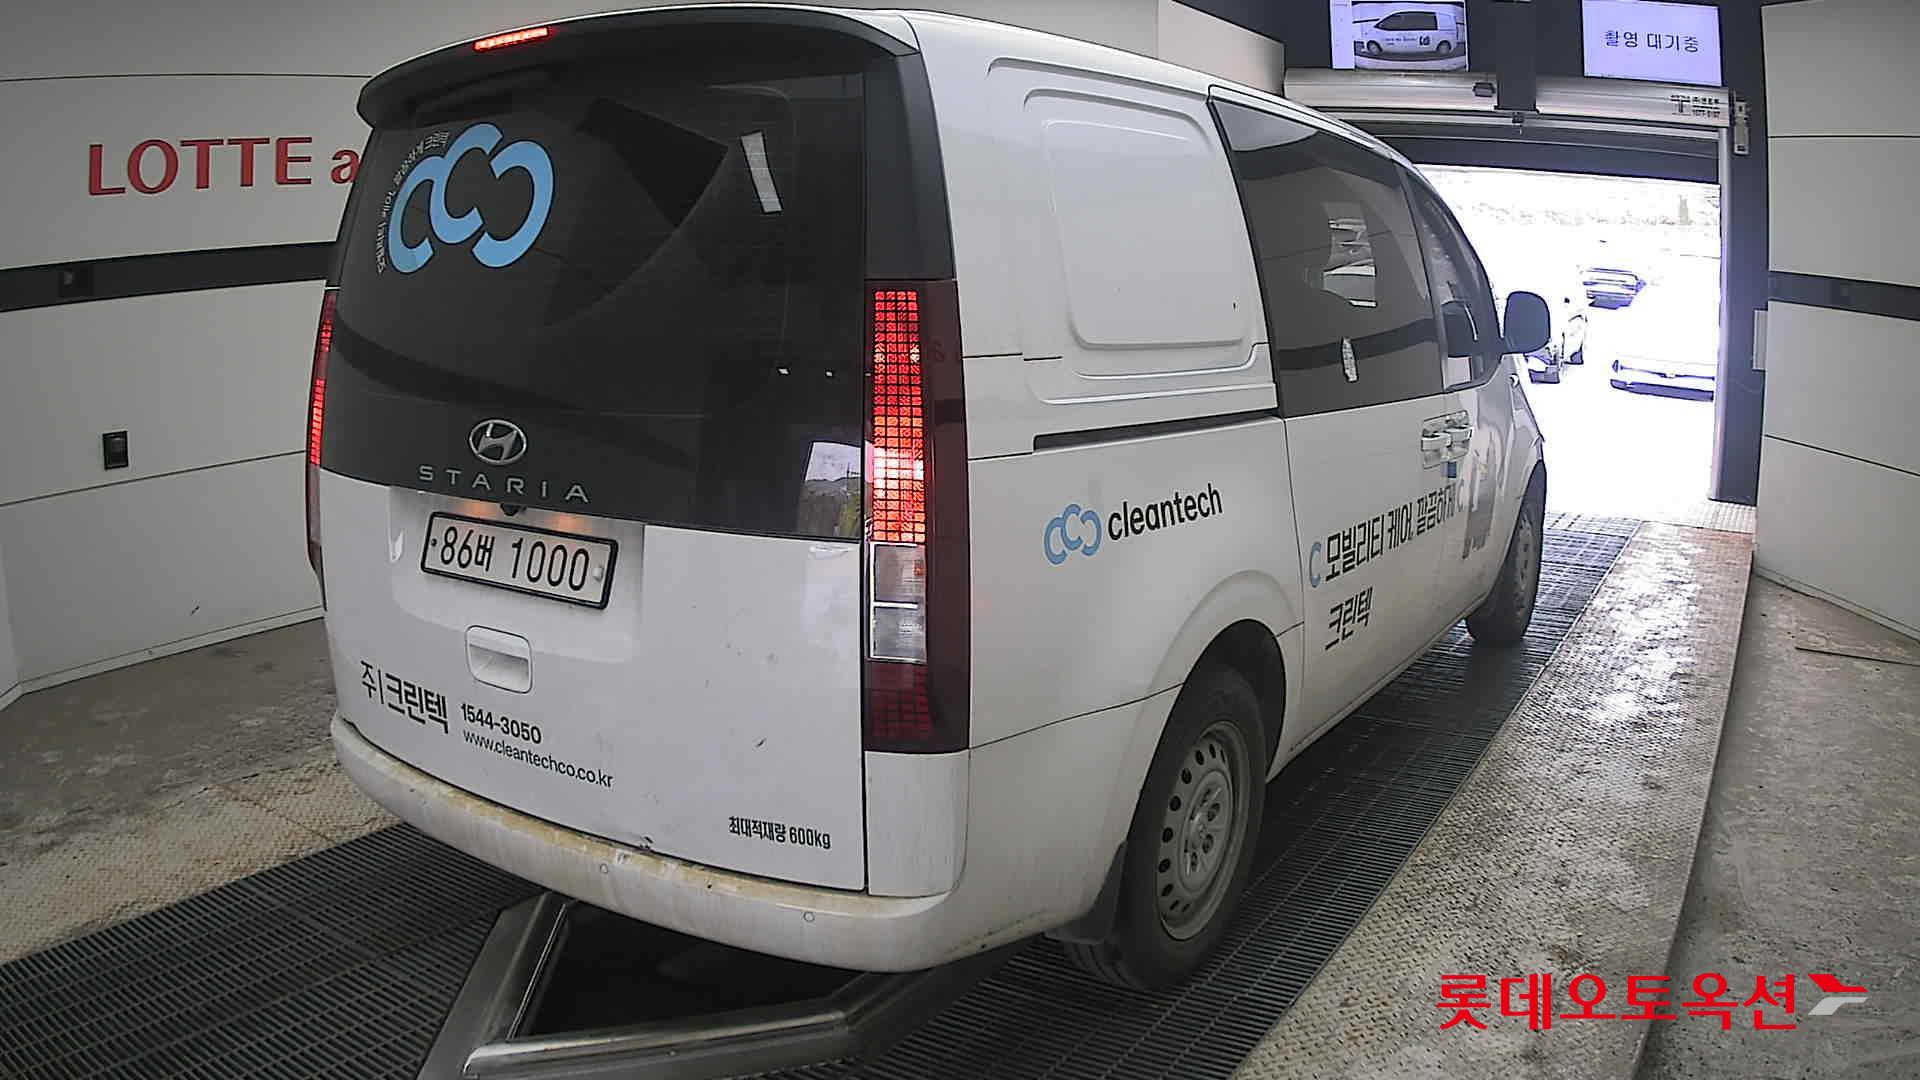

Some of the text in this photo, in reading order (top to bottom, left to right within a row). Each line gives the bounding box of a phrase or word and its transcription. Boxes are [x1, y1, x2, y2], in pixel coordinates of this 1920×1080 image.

[1646, 32, 1699, 53] 대기중
[88, 136, 313, 196] LOTTE
[418, 464, 589, 503] STARIA
[1107, 482, 1223, 541] cleantech
[440, 526, 590, 592] 86버 1000
[1325, 514, 1385, 582] 모빌리티
[1325, 586, 1374, 651] 크린텍
[460, 703, 543, 745] 1544-3050
[463, 729, 614, 788] www.cleantechco.co.kr
[728, 815, 831, 850] 최대적재량 600kg
